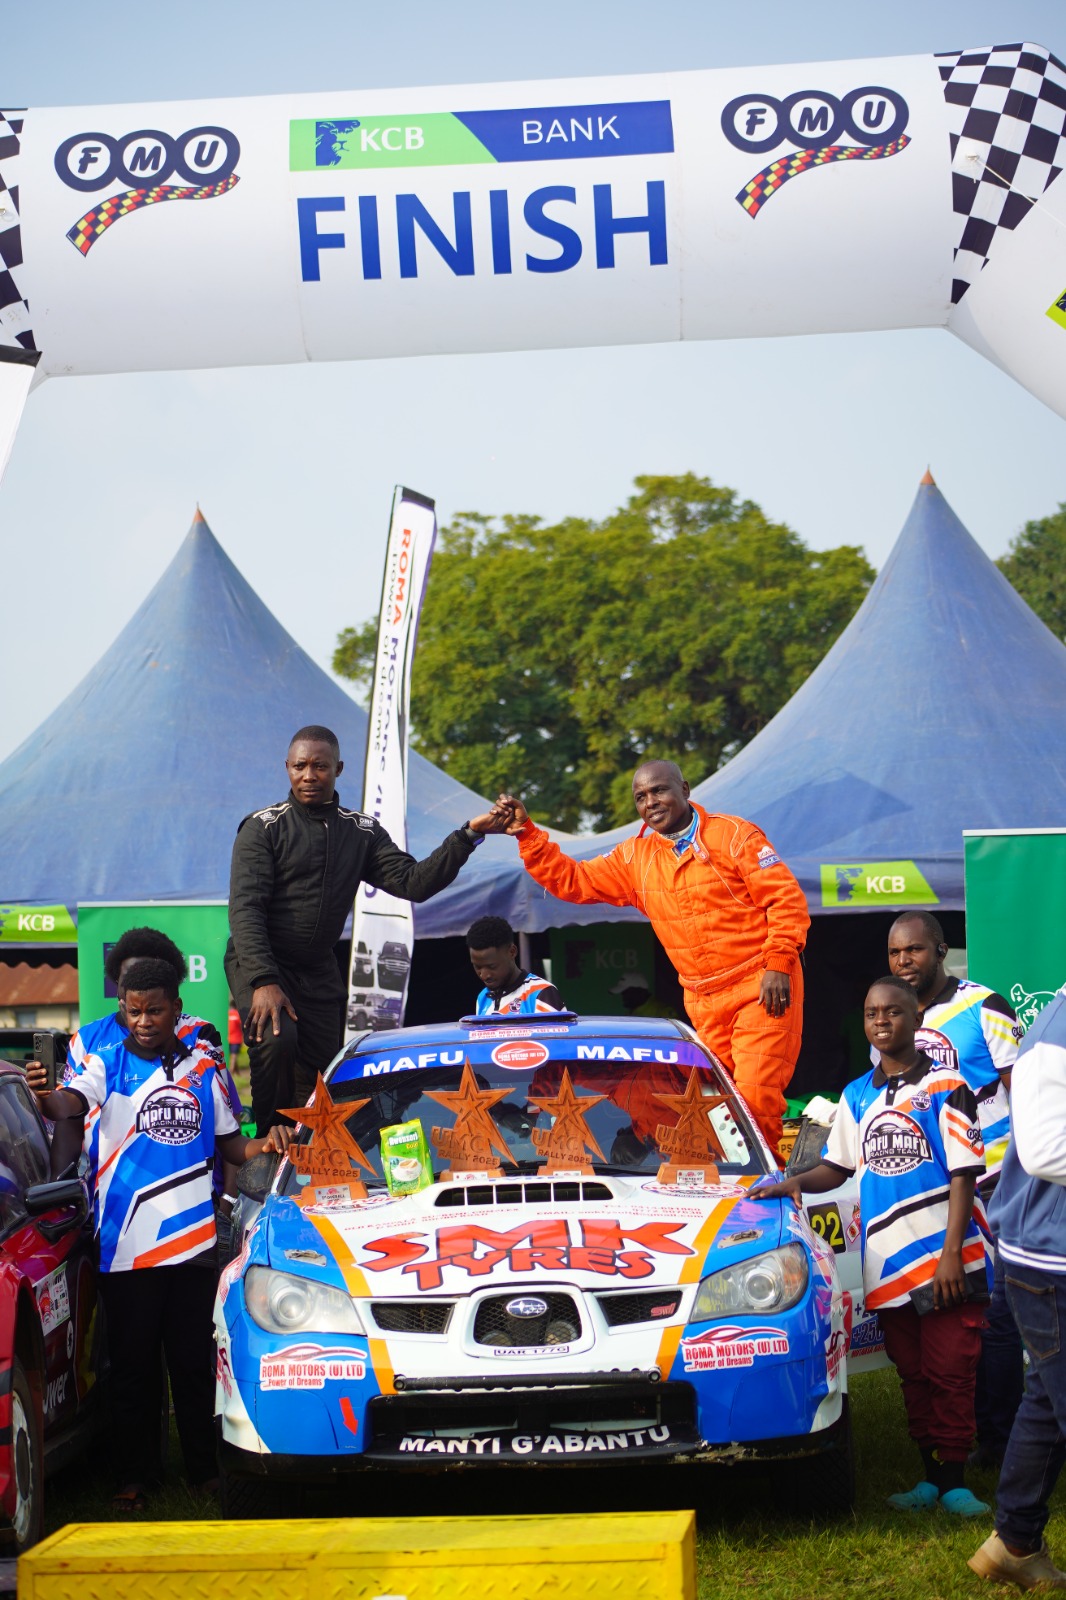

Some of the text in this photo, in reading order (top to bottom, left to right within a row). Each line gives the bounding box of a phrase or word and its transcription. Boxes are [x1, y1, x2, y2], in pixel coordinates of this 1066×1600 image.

[361, 114, 620, 151] KCB BANK
[297, 180, 669, 282] FINISH
[393, 528, 412, 625] ROMA
[866, 876, 906, 893] KCB
[18, 914, 55, 931] KCB
[595, 949, 639, 969] KCB
[363, 1050, 463, 1077] MAFU
[577, 1045, 679, 1063] MAFU
[140, 1107, 200, 1131] MAFU MAF
[431, 1127, 485, 1154] UMC
[531, 1128, 579, 1152] UMC
[656, 1125, 703, 1150] UMC
[864, 1134, 929, 1161] MAFU MAFU
[289, 1146, 345, 1167] UMC
[440, 1149, 498, 1166] RALLY 2025
[538, 1148, 591, 1166] RALLY 2025
[661, 1144, 713, 1162] RALLY 2025
[870, 1148, 918, 1157] RACING TEAM
[297, 1165, 359, 1178] RALLY 2025
[811, 1211, 844, 1247] 22
[356, 1218, 699, 1272] SMK
[401, 1247, 656, 1291] TYRES
[684, 1340, 788, 1360] ROMA MOTORS (U) LTD
[262, 1364, 363, 1378] ROMA MOTORS (U) LTD
[717, 1358, 725, 1367] of
[726, 1356, 752, 1366] Dreams
[296, 1378, 322, 1386] Dreams
[400, 1425, 670, 1455] MANYI G'ABANTU
